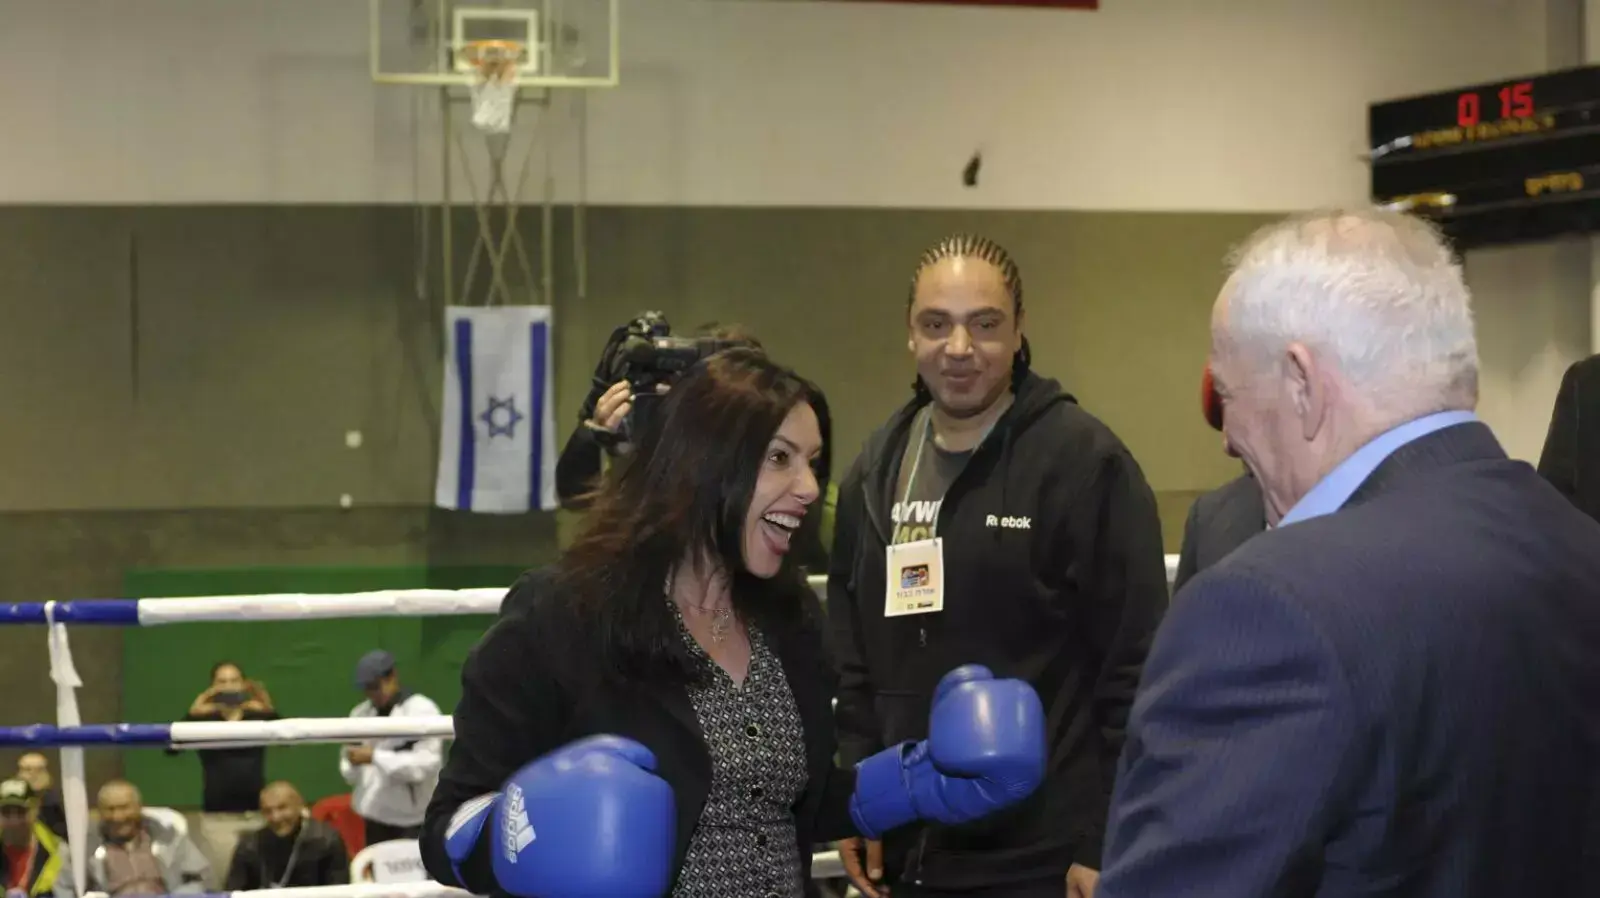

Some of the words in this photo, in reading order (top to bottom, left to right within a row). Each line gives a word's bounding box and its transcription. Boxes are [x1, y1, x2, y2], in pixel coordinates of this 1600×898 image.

[1497, 81, 1535, 118] 15
[891, 500, 941, 522] AYW
[985, 514, 1031, 529] Reebok
[504, 782, 522, 864] adidas
